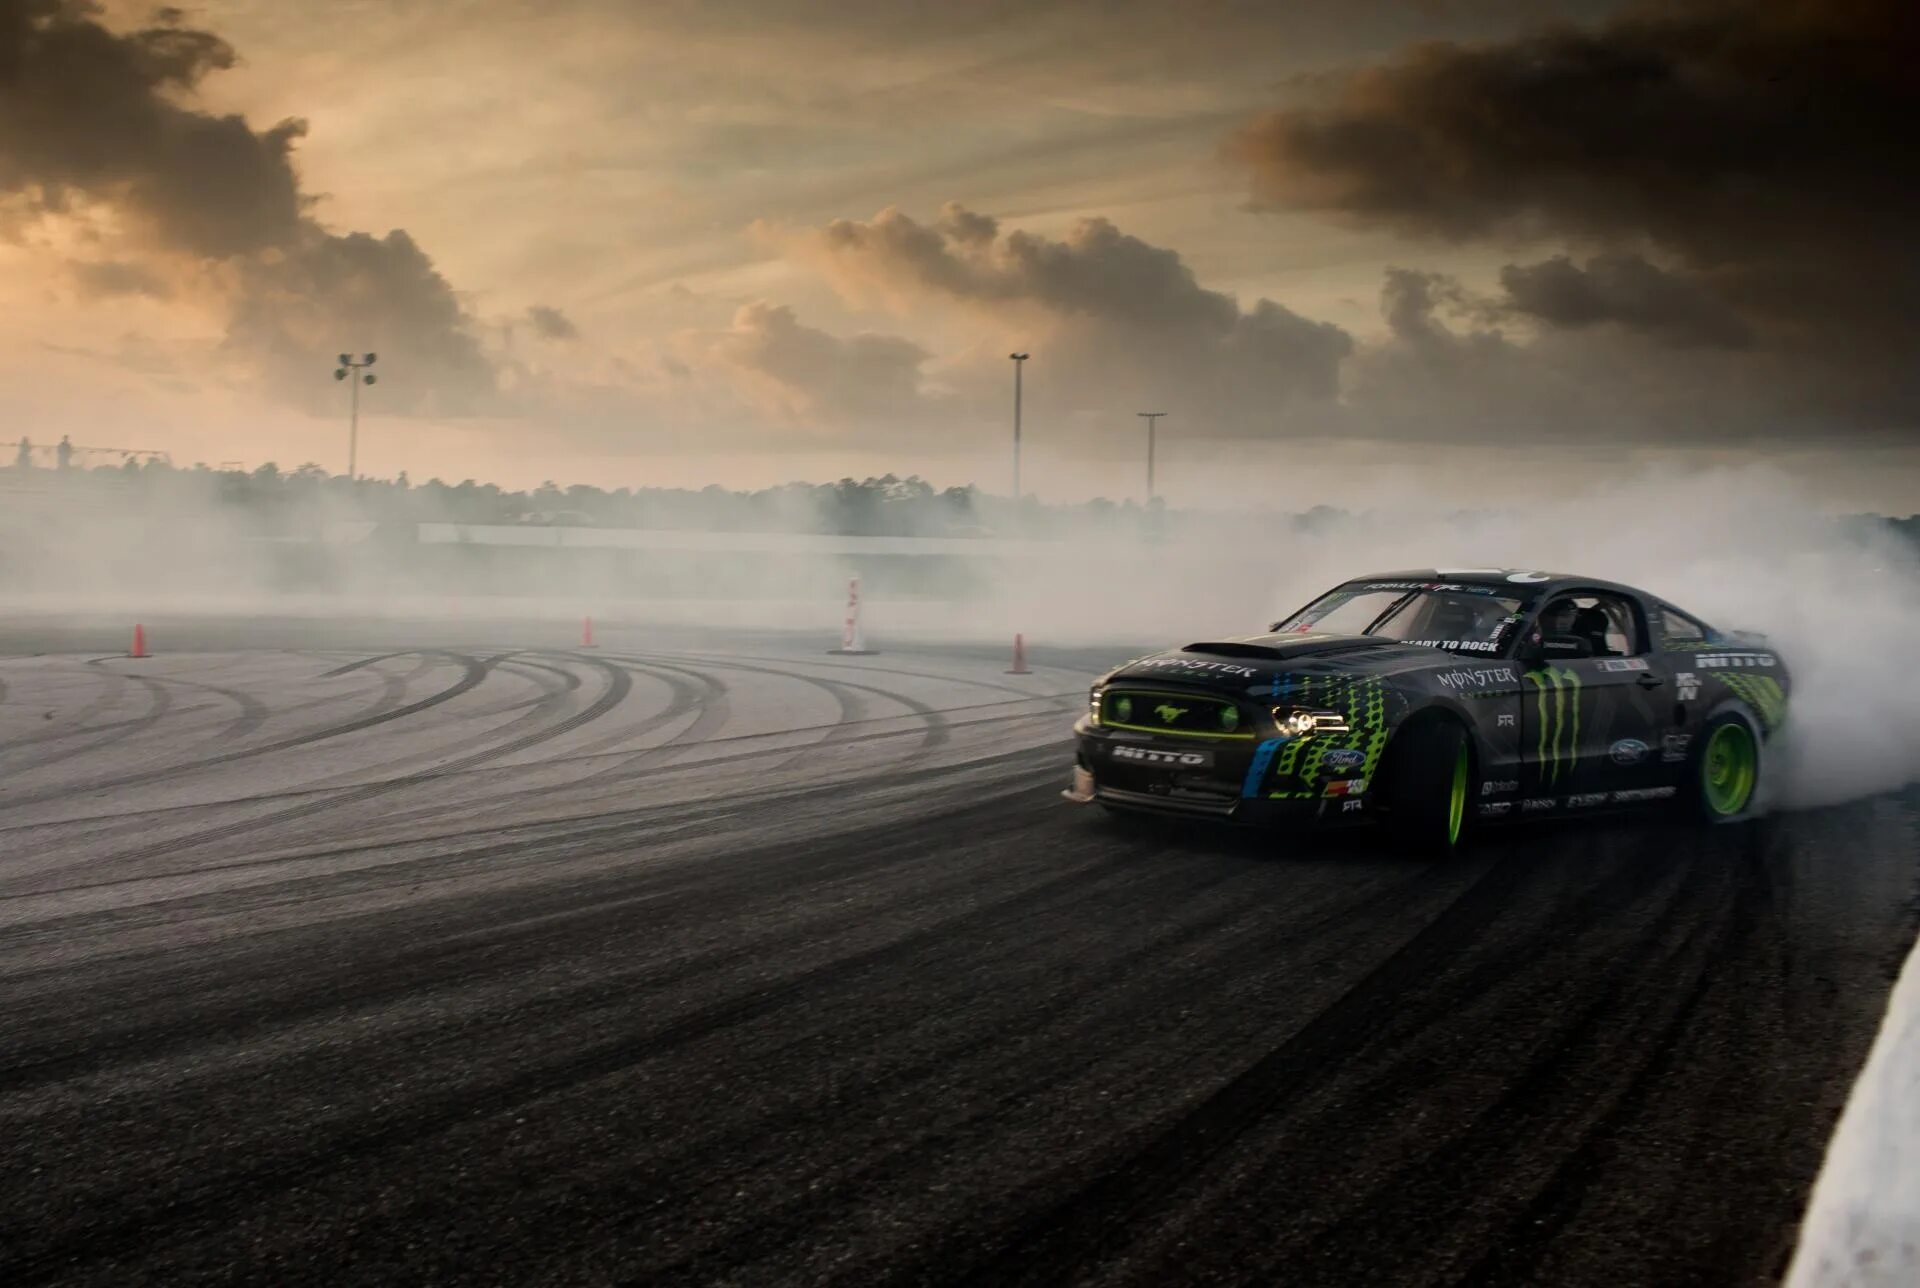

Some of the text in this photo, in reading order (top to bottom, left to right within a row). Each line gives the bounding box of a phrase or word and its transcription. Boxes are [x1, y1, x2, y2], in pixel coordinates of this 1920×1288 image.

[1441, 640, 1458, 649] TO
[1459, 641, 1499, 652] ROCK
[1437, 668, 1518, 689] MONSTER
